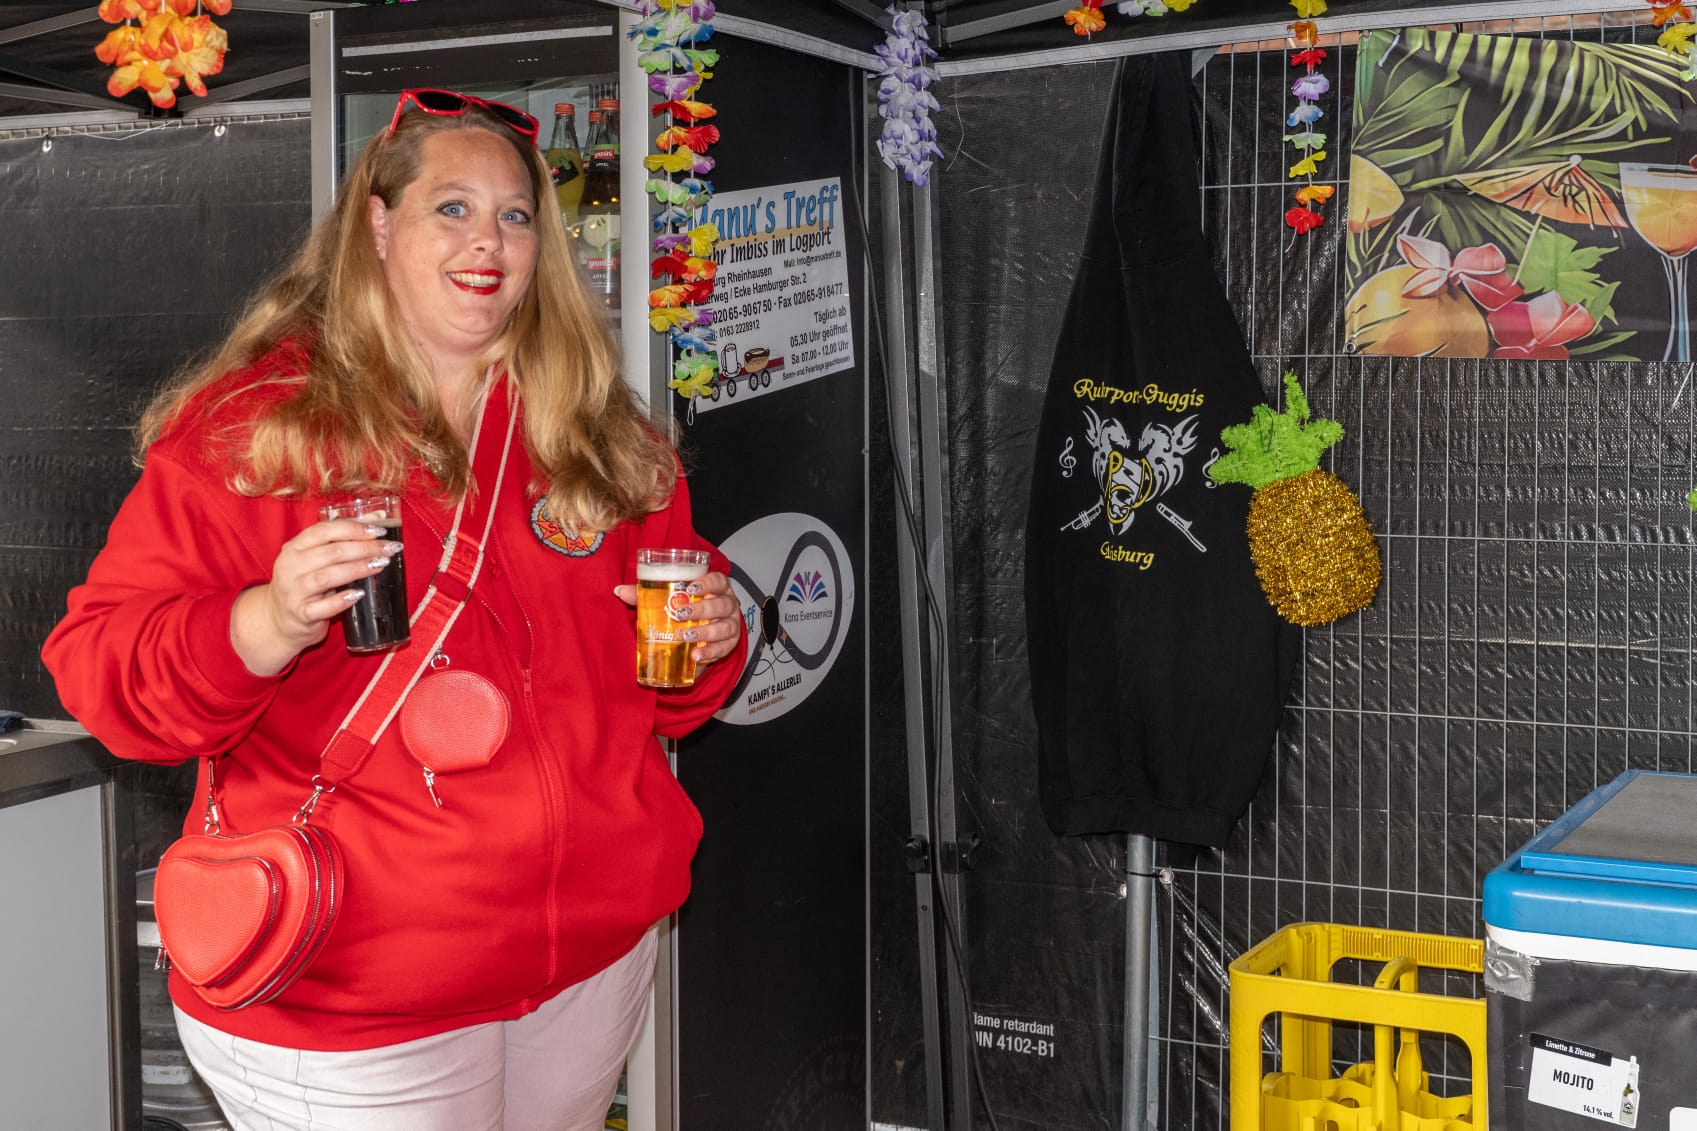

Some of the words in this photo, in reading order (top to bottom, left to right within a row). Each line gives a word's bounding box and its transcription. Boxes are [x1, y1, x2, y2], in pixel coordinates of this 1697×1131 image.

[783, 184, 839, 230] Treff
[730, 238, 768, 264] Imbiss
[772, 235, 786, 256] im
[789, 227, 832, 253] Logport
[727, 267, 773, 284] Rheinhausen
[734, 285, 752, 299] Ecke
[752, 278, 789, 294] Hamburger
[790, 275, 802, 286] Str.
[802, 272, 807, 284] 2
[778, 296, 792, 309] Fax
[814, 307, 837, 324] Täglich
[838, 305, 847, 317] ab
[719, 325, 734, 338] 0163
[790, 332, 808, 348] 05.30
[809, 330, 821, 343] Uhr
[822, 323, 848, 342] geöffnet
[791, 354, 800, 365] Sa
[801, 349, 817, 362] 07.00
[822, 343, 837, 356] 12.00
[838, 340, 849, 351] Uhr
[797, 368, 805, 376] und
[1100, 541, 1155, 571] Disburg
[800, 609, 833, 622] Eventservice
[776, 673, 802, 693] ALLERLEI
[973, 1011, 1000, 1029] lame
[1003, 1018, 1054, 1037] retardant
[996, 1034, 1054, 1058] 4102-B1
[1545, 1039, 1568, 1051] Limette
[1574, 1047, 1596, 1059] Zitrone
[1552, 1069, 1594, 1091] MOJITO
[1596, 1108, 1603, 1116] %
